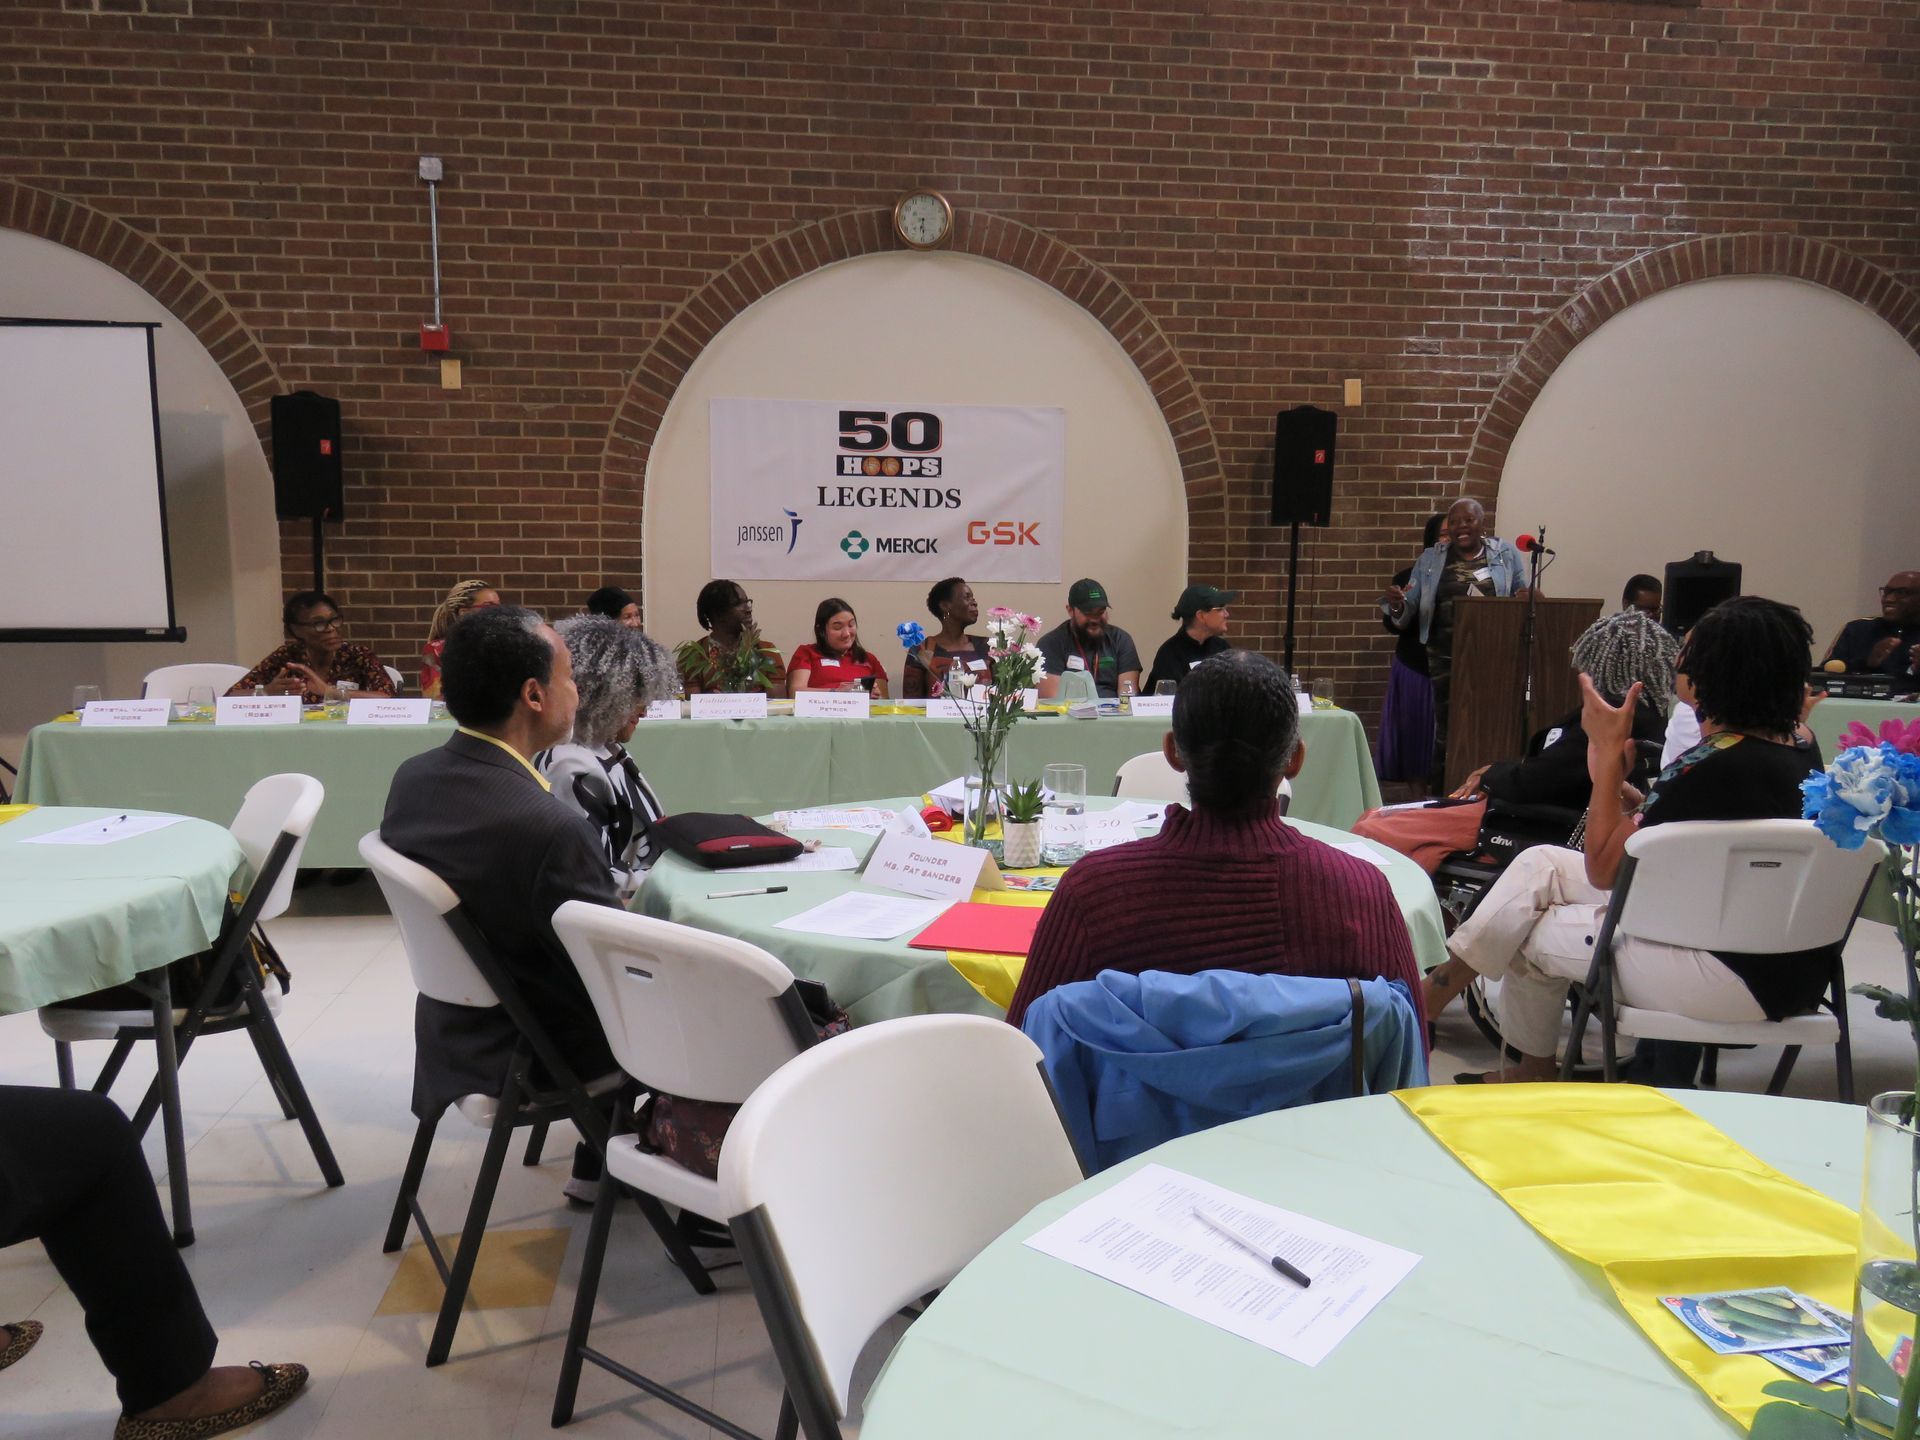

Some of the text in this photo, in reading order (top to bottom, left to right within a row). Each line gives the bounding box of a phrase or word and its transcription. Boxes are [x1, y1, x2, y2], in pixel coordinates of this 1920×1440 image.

[838, 410, 942, 453] 50
[817, 486, 962, 509] LEGENDS
[967, 521, 1041, 546] GSK
[876, 538, 939, 554] MERCK
[908, 852, 948, 867] FOUNDER
[884, 860, 962, 885] MS. PAT SANDERS
